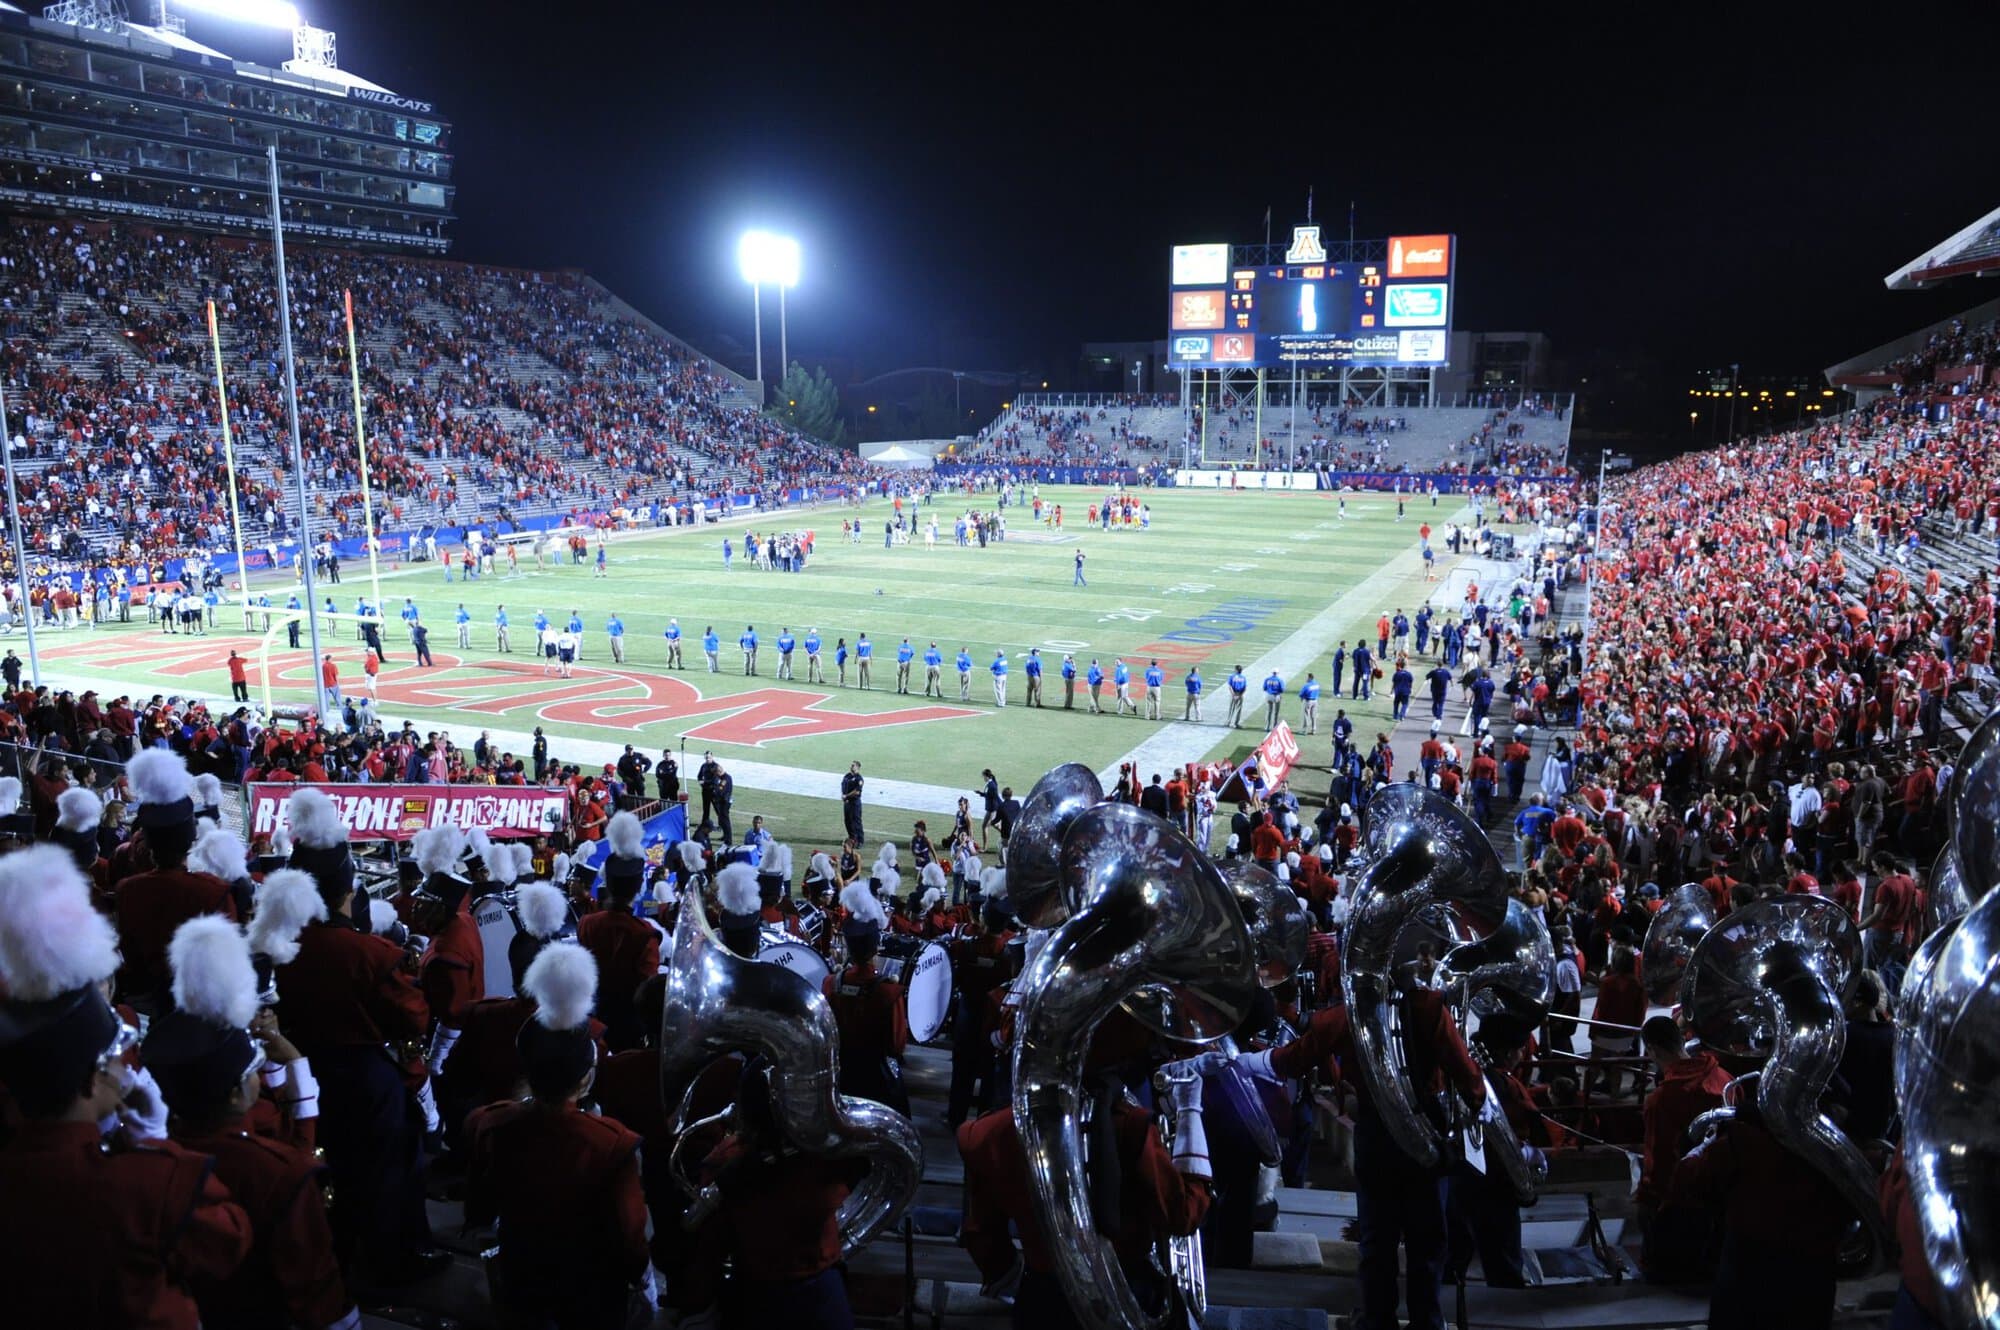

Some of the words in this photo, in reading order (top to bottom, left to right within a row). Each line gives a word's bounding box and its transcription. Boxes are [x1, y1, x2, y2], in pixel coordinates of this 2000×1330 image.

[353, 87, 433, 113] WILDCATS
[1353, 337, 1398, 350] Citizen
[1158, 597, 1288, 643] DOWN
[38, 631, 995, 748] ARIZONA
[342, 796, 404, 831] ZONE
[430, 797, 475, 829] RED
[494, 797, 544, 829] ZONE
[483, 910, 503, 926] YAMAHA
[774, 951, 794, 967] AHA
[921, 951, 943, 974] YAMAHA
